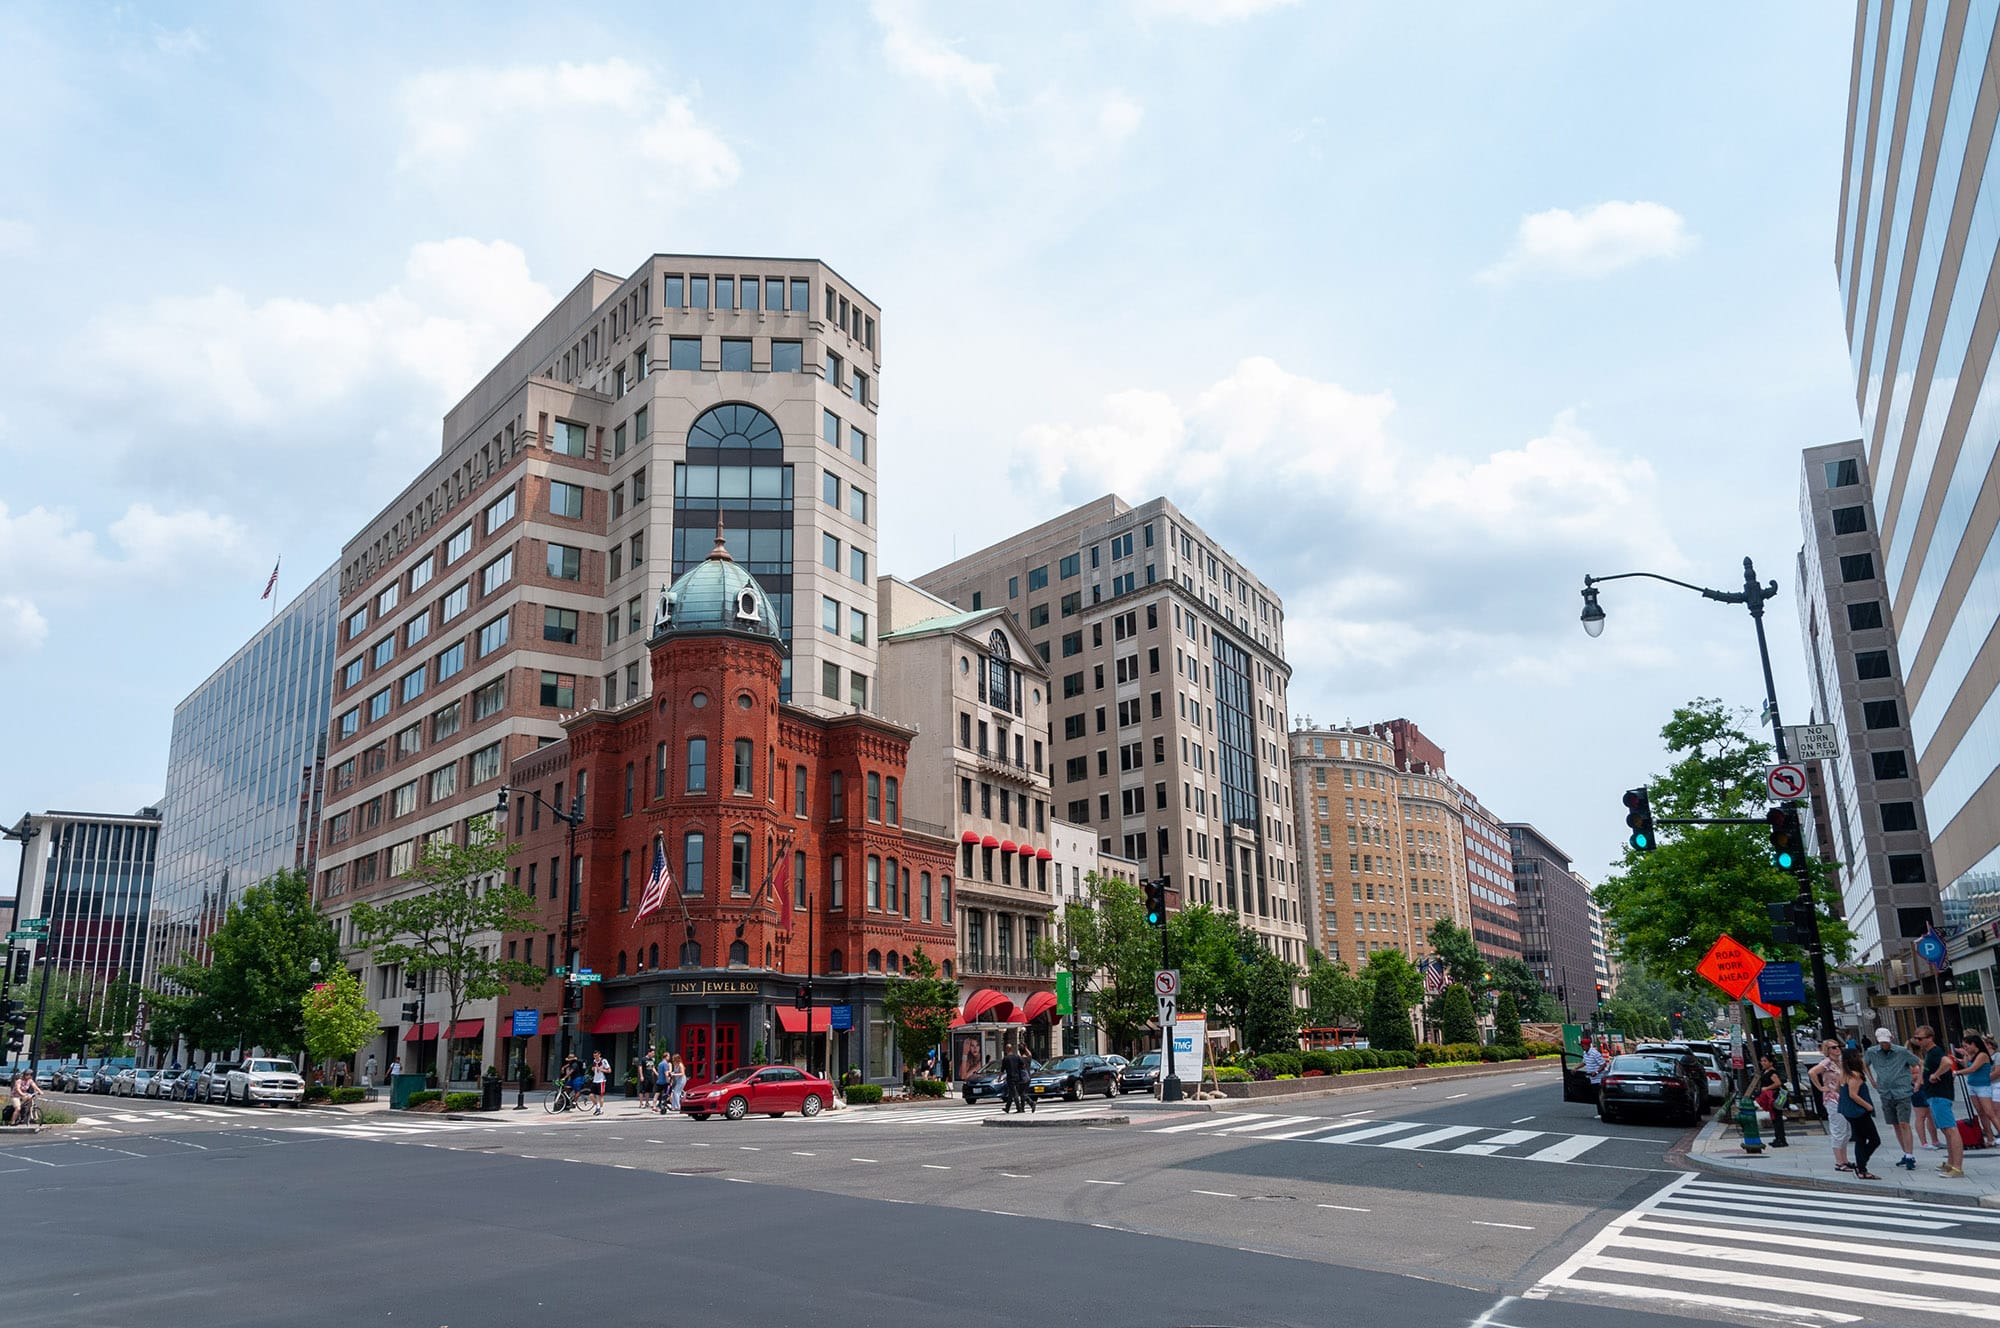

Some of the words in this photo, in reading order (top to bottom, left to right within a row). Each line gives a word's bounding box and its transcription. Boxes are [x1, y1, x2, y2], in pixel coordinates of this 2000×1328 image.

[1807, 727, 1822, 735] NO
[1804, 734, 1829, 743] TURN
[1800, 743, 1813, 751] ON
[1816, 741, 1835, 750] RED
[1800, 749, 1838, 759] 7AM-7PM
[1924, 942, 1935, 955] P
[1715, 949, 1742, 961] ROAD
[1717, 960, 1744, 972] WORK
[1718, 971, 1750, 982] AHEAD
[670, 982, 697, 992] TINY
[701, 980, 736, 997] JEWEL
[740, 982, 759, 991] BOX
[135, 1003, 145, 1034] PARK
[1174, 1041, 1191, 1050] TMG
